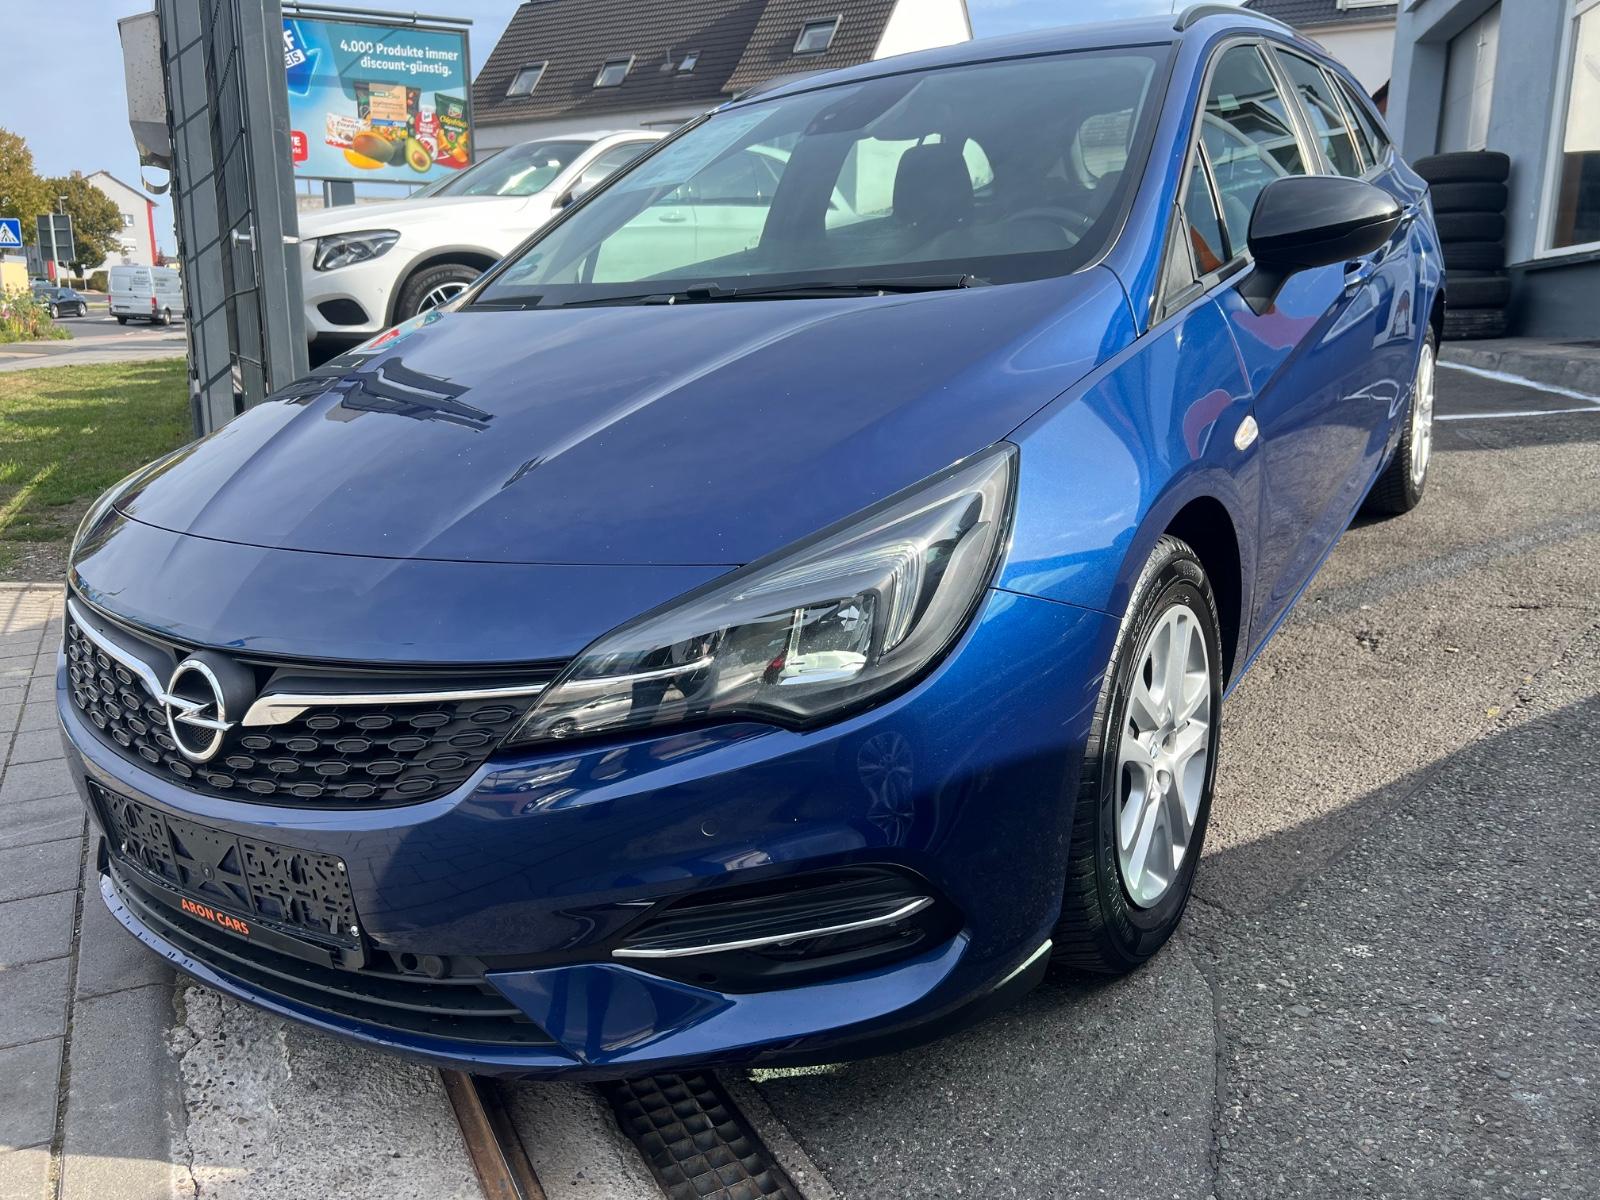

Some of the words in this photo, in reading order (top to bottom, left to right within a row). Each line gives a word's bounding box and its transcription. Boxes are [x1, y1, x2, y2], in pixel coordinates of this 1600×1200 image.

[340, 40, 374, 54] 4.000
[376, 43, 424, 58] Produkte
[426, 47, 459, 61] immer
[360, 57, 453, 77] discount-günstig.
[181, 898, 216, 921] ARON
[216, 912, 249, 935] CARS
